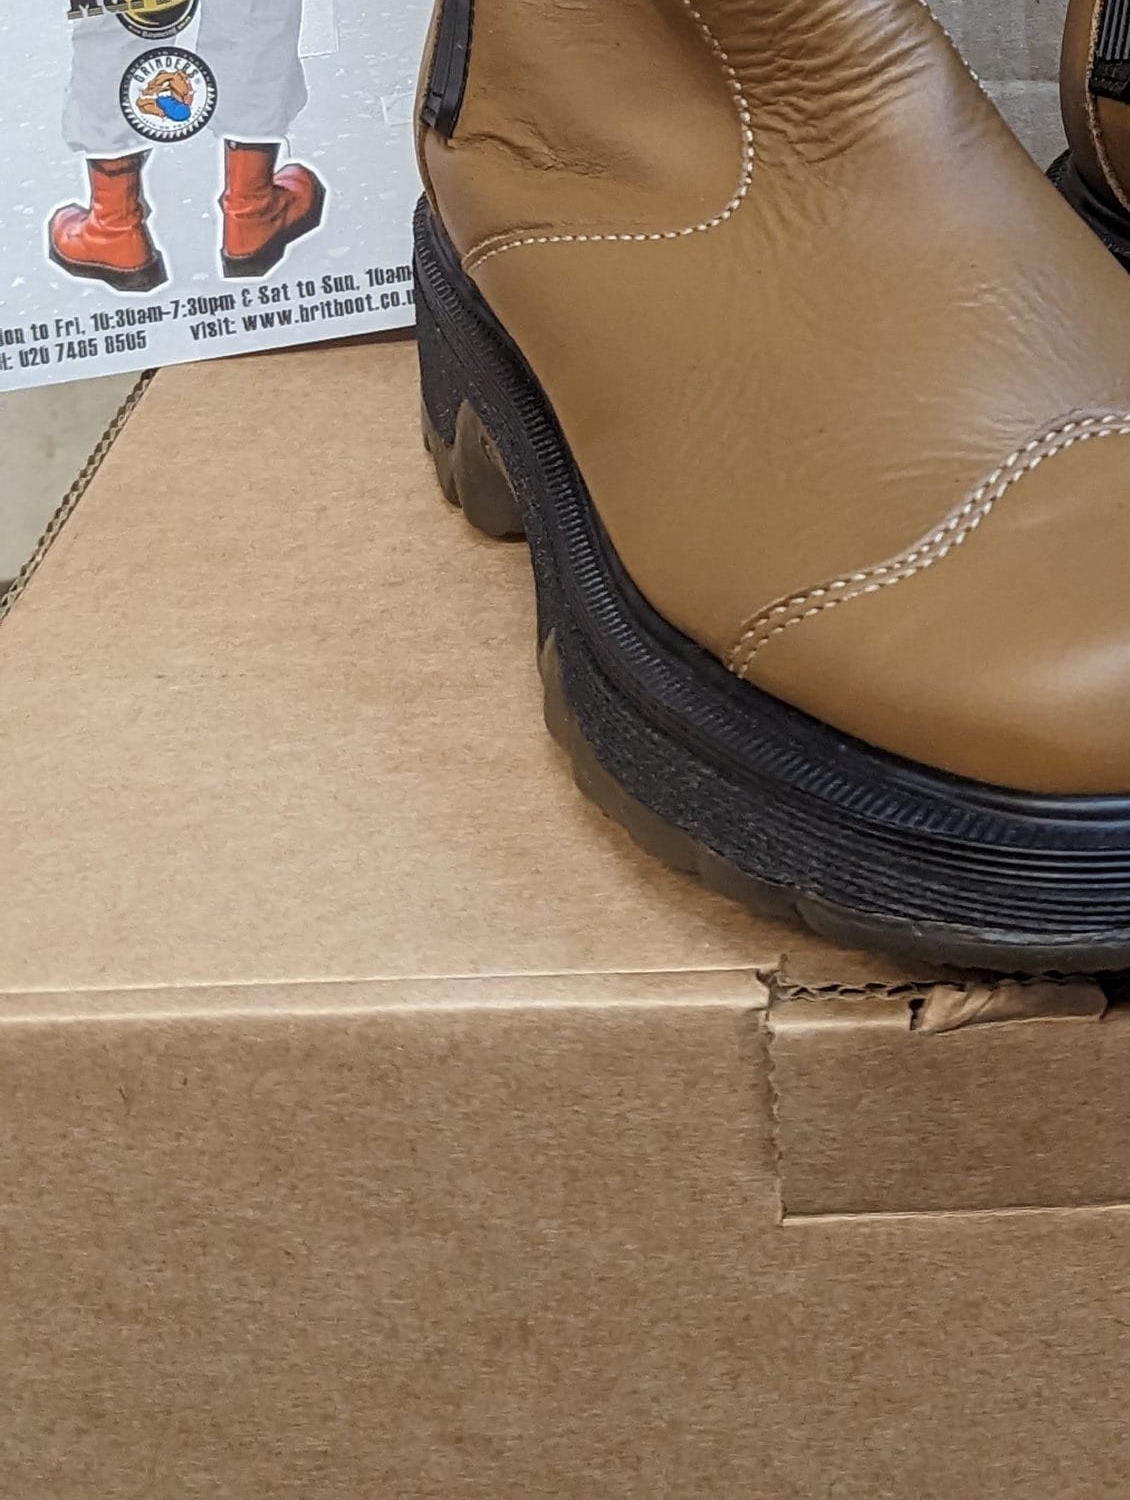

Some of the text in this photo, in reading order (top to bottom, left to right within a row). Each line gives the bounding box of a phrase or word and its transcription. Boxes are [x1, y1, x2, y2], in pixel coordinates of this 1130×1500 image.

[30, 323, 50, 341] to
[54, 316, 86, 338] Fri,
[241, 287, 254, 308] &
[257, 283, 290, 305] Sat
[296, 280, 316, 298] to
[320, 274, 361, 294] Sun,
[364, 264, 413, 288] 10am
[242, 289, 415, 333] www.britboot.co.u
[18, 345, 50, 368] 020
